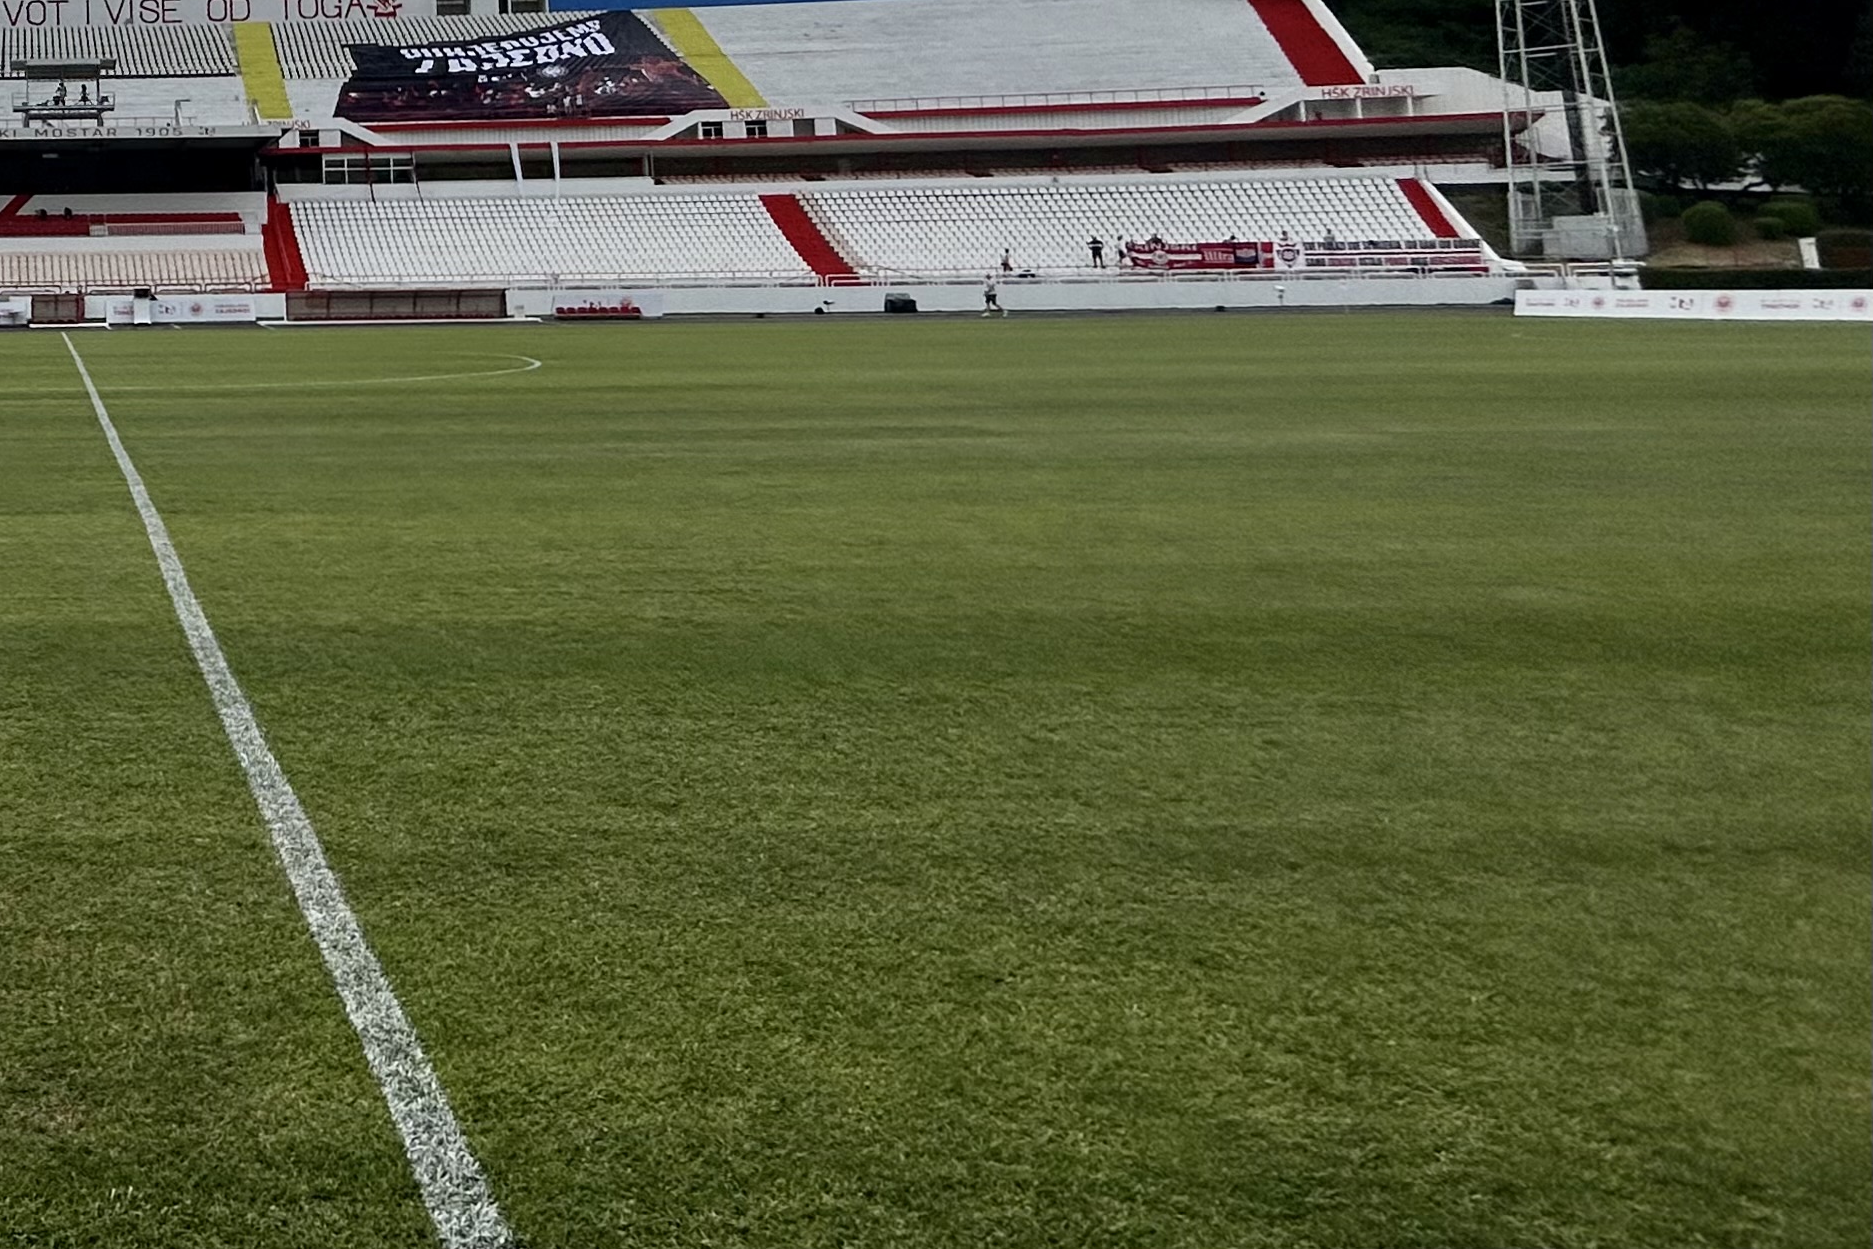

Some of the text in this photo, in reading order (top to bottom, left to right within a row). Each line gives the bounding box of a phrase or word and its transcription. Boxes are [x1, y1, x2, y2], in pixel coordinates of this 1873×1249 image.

[85, 0, 90, 25] I
[34, 128, 118, 138] MOSTAR
[136, 127, 183, 137] 1905
